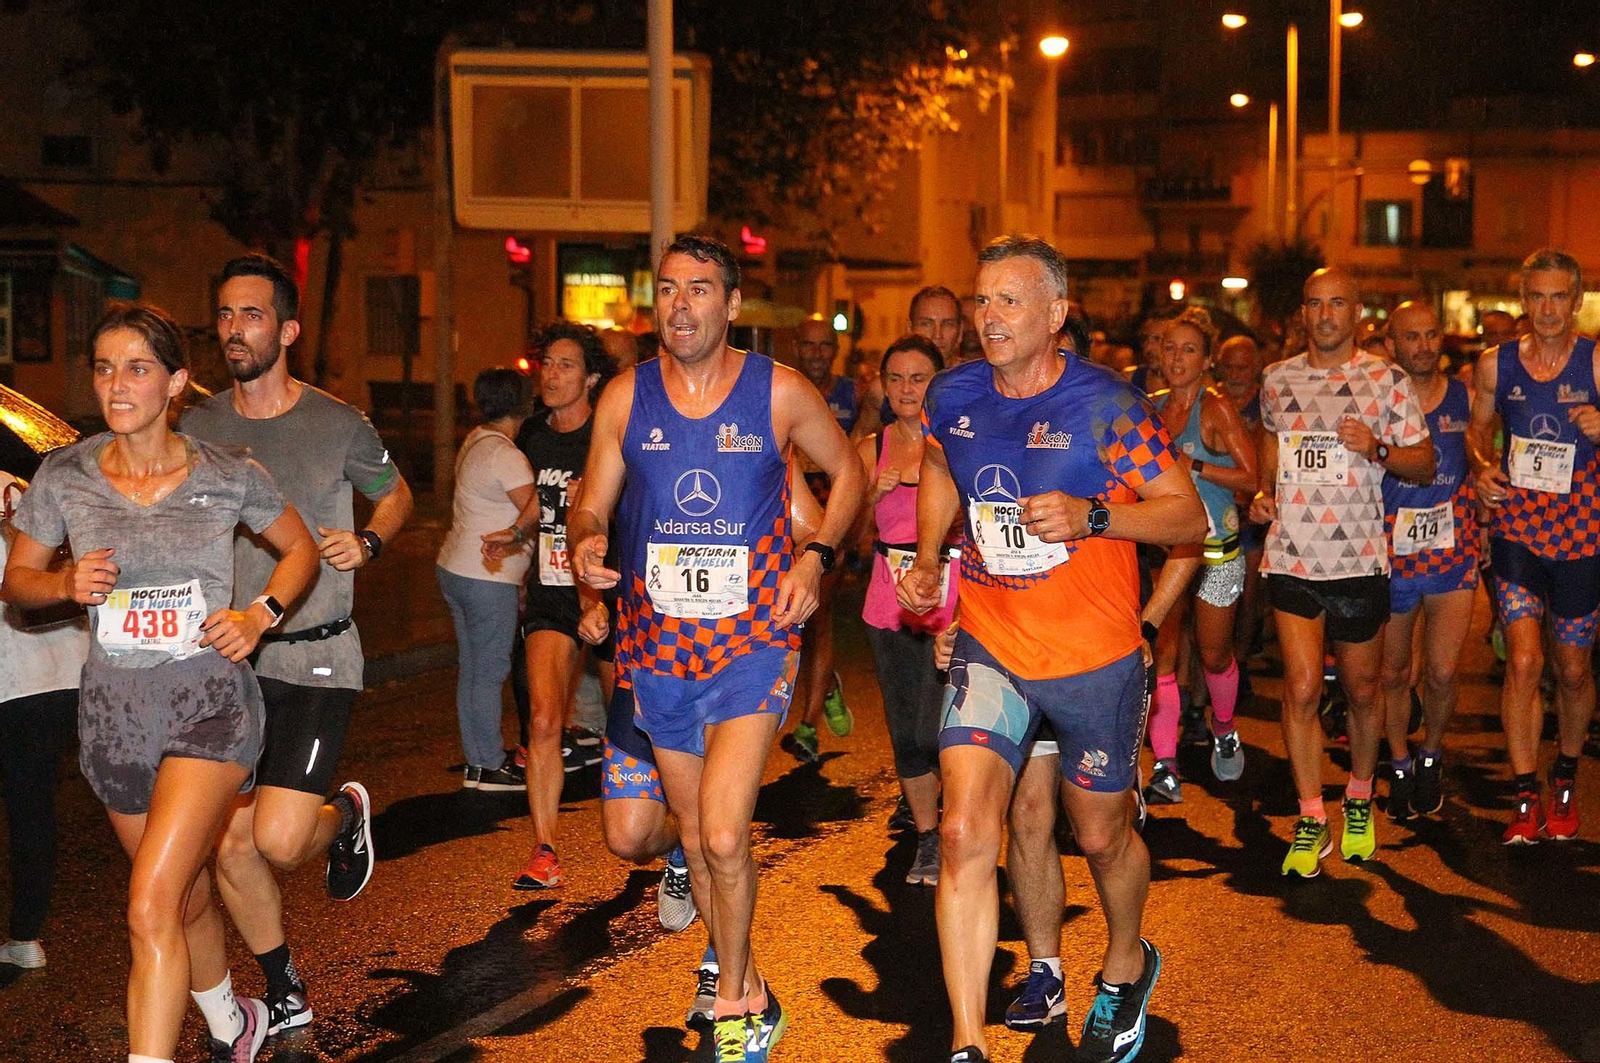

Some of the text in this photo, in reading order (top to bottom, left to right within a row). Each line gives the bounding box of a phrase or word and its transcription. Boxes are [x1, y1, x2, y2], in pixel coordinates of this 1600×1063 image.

[949, 426, 976, 439] VIATOR
[1302, 435, 1337, 443] NOCTURN
[641, 443, 671, 451] VIATOR
[1294, 449, 1327, 469] 105
[1532, 456, 1543, 472] 5
[537, 468, 573, 489] NOC
[994, 505, 1026, 517] NOCTU
[994, 515, 1006, 524] DE
[999, 524, 1026, 549] 10
[1407, 522, 1439, 541] 414
[677, 546, 737, 558] NOCTURNA
[549, 550, 571, 570] 42
[675, 556, 735, 568] DE HUELVA
[681, 569, 709, 593] 16
[130, 586, 193, 600] NOCTURNA
[129, 597, 192, 610] DE HUELVA
[122, 609, 179, 639] 438
